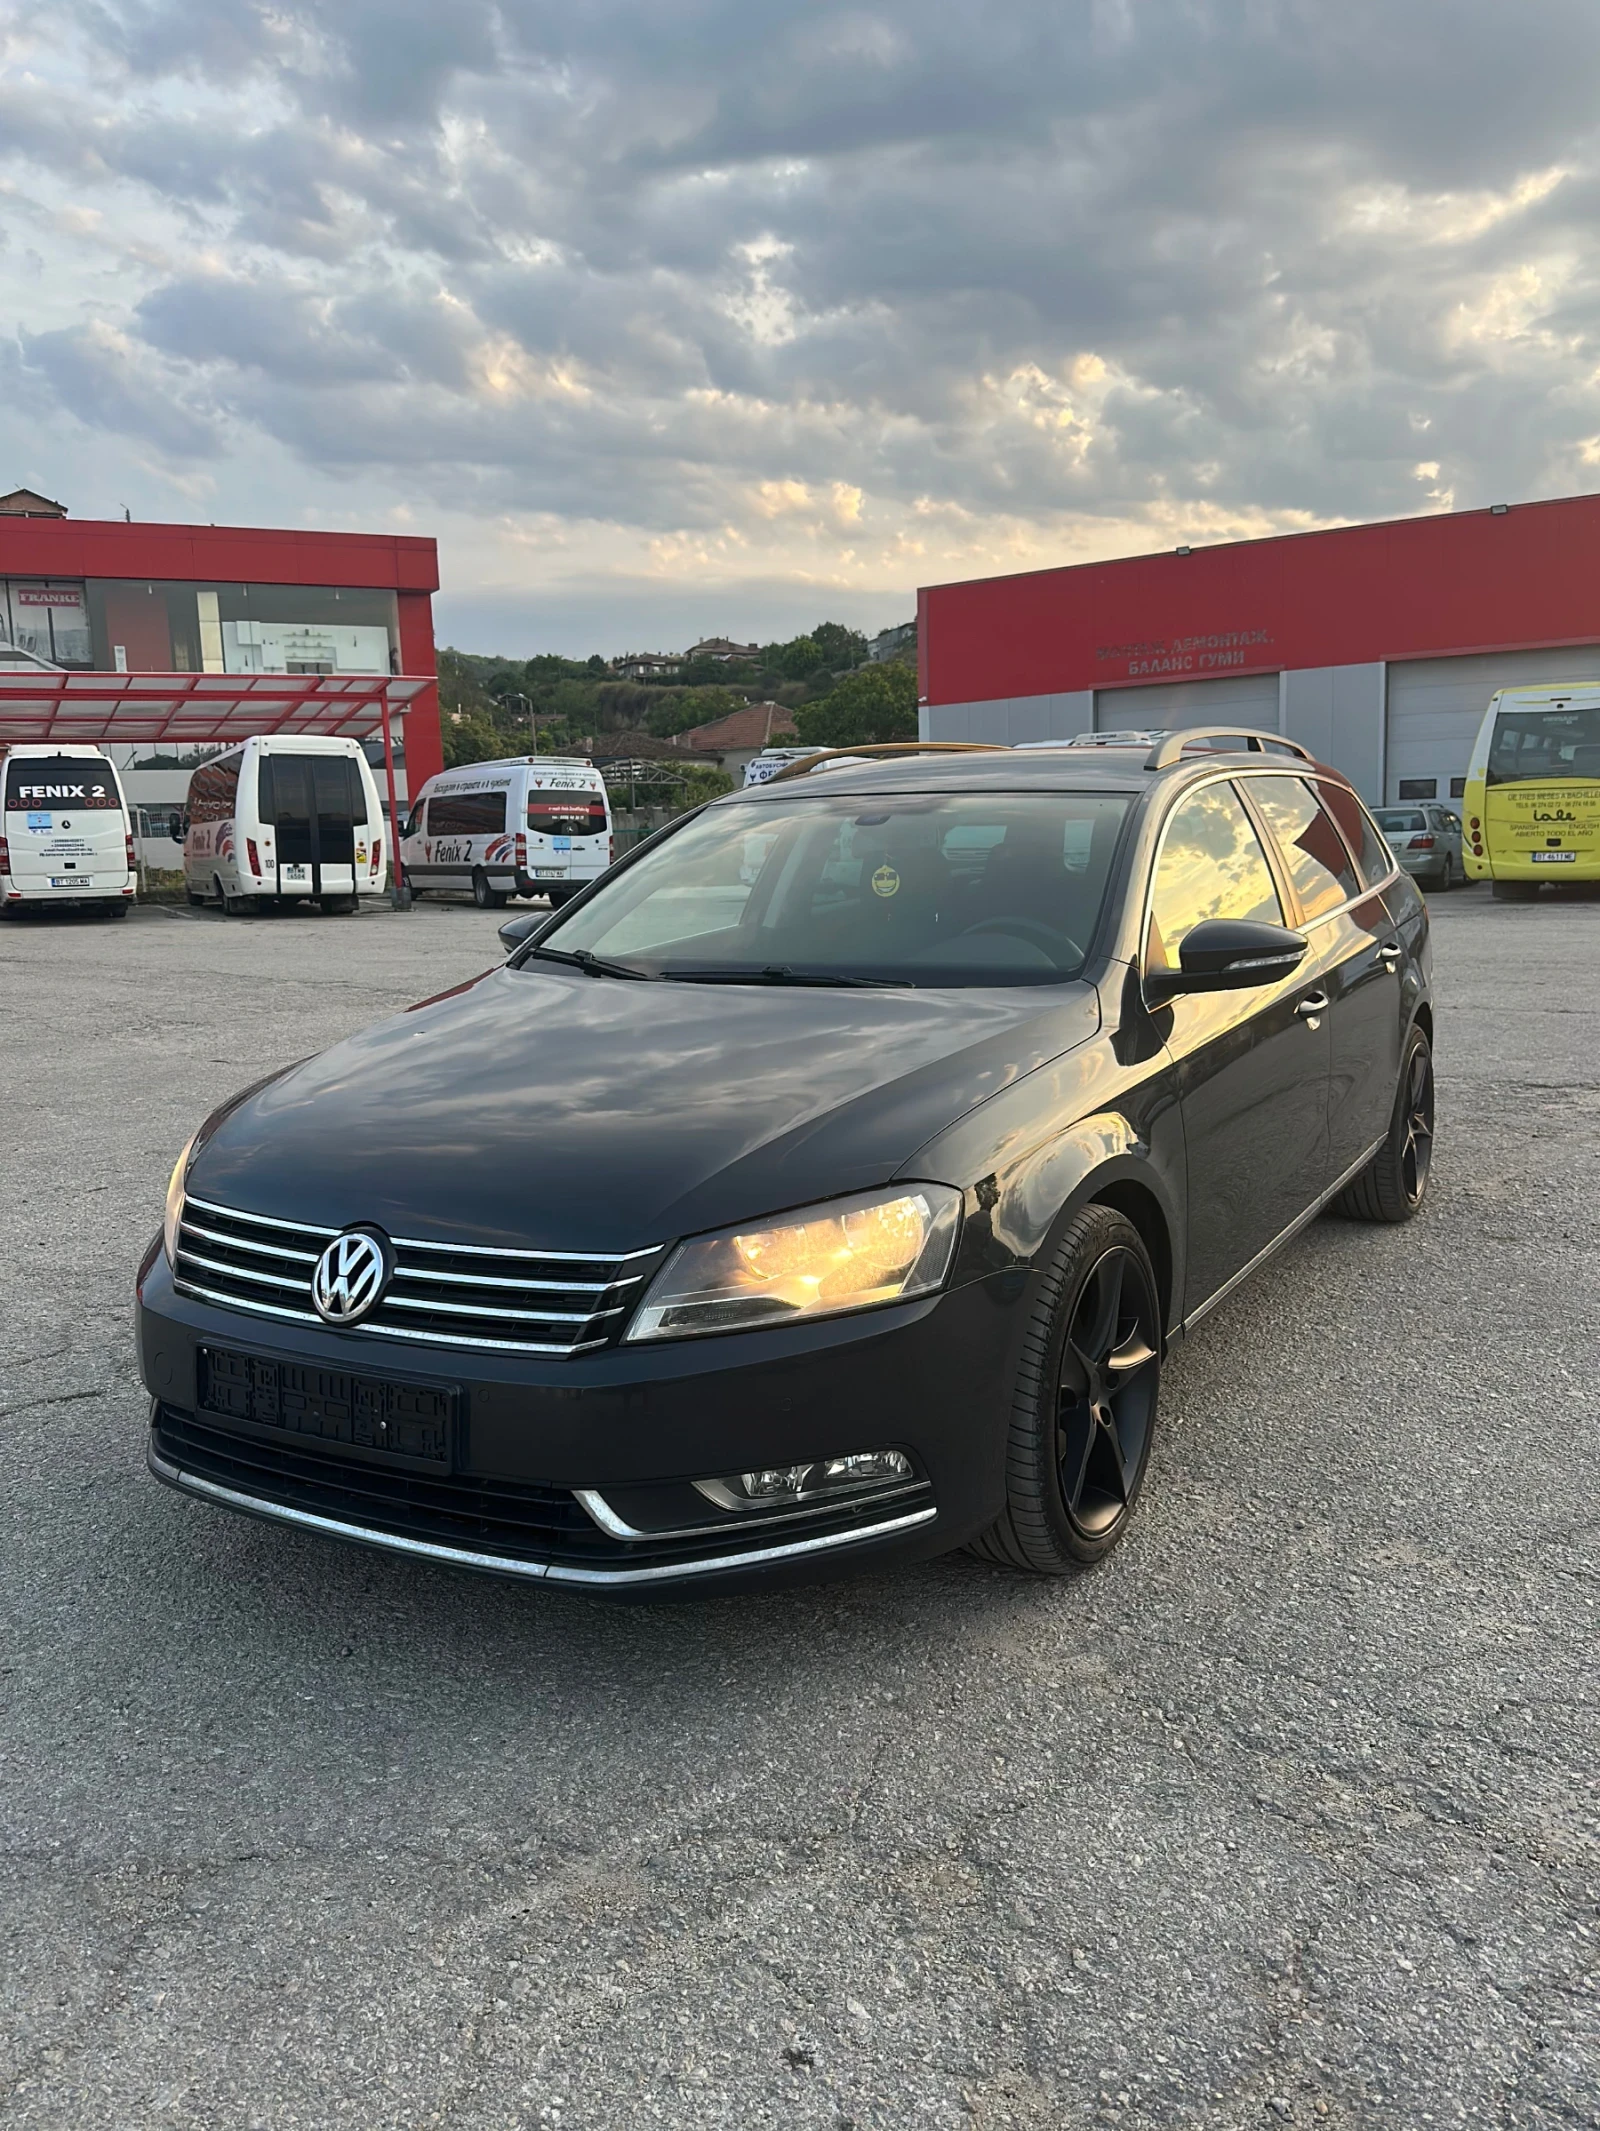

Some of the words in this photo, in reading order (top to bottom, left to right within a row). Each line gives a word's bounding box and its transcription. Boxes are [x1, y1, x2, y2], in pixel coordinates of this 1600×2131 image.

[19, 593, 79, 603] FRANKE
[1128, 656, 1193, 675] БАЛАНС
[1198, 650, 1245, 668] ГУМИ
[550, 777, 576, 788] Fenix
[579, 780, 586, 788] 2
[19, 785, 86, 798] FENIX
[91, 785, 106, 798] 2
[435, 839, 462, 862] Fenix
[464, 840, 473, 862] 2
[265, 860, 275, 869] 100
